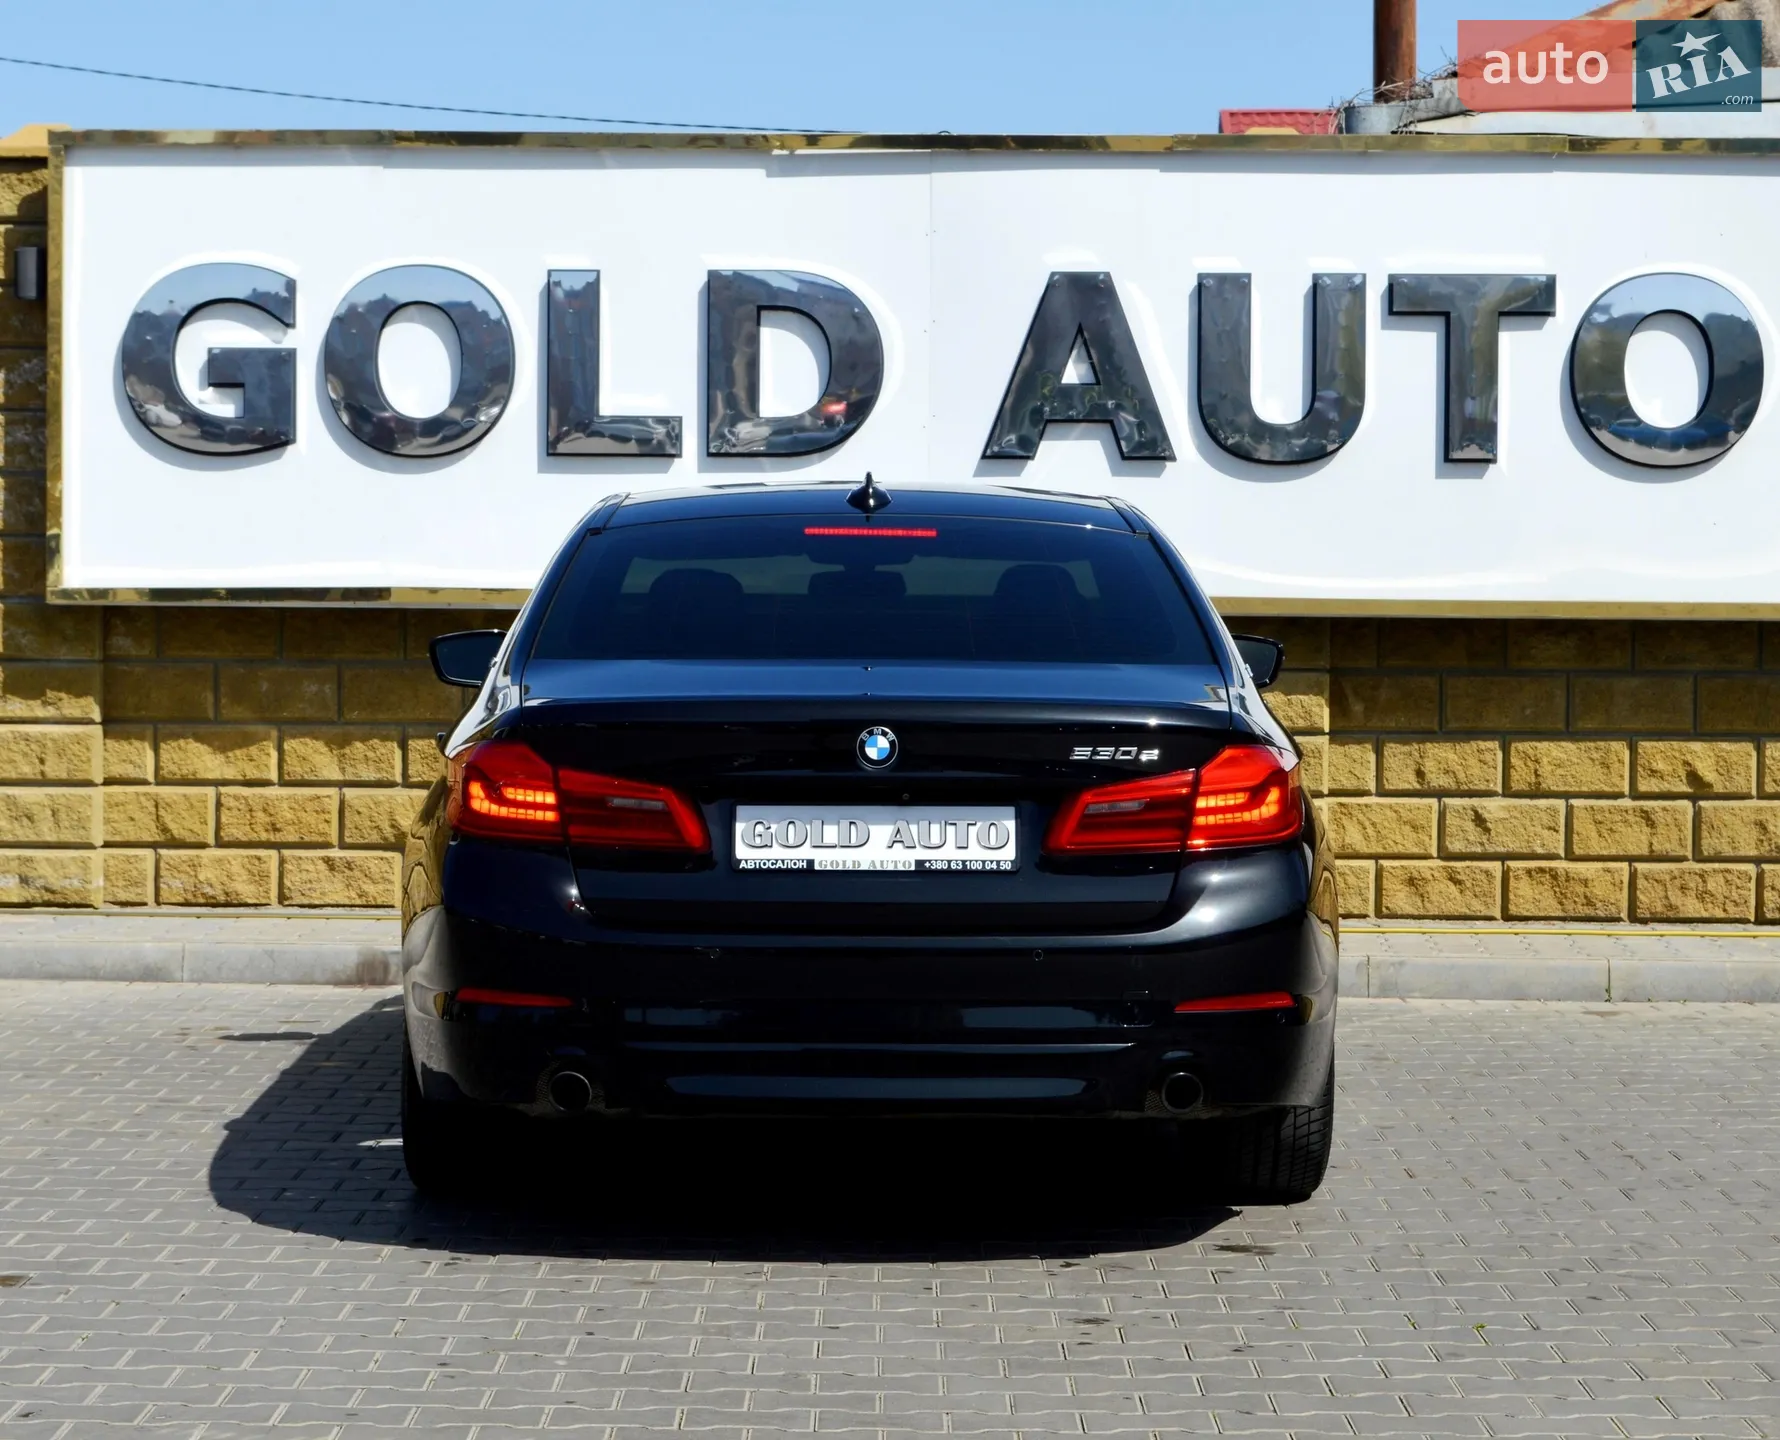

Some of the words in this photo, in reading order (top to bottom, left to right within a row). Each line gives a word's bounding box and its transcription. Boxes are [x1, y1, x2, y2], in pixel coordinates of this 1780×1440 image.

[122, 262, 884, 458] GOLD
[981, 271, 1765, 469] AUTO
[860, 728, 896, 742] BMW
[1069, 746, 1160, 762] 530e
[741, 818, 870, 849] GOLD
[886, 819, 1010, 850] AUTO
[739, 859, 807, 870] АВТОСАЛОН
[818, 859, 861, 870] GOLD
[868, 859, 912, 870] AUTO
[924, 860, 948, 870] +380
[950, 860, 963, 870] 63
[965, 860, 982, 870] 100
[985, 860, 997, 870] 04
[999, 860, 1011, 870] 50
